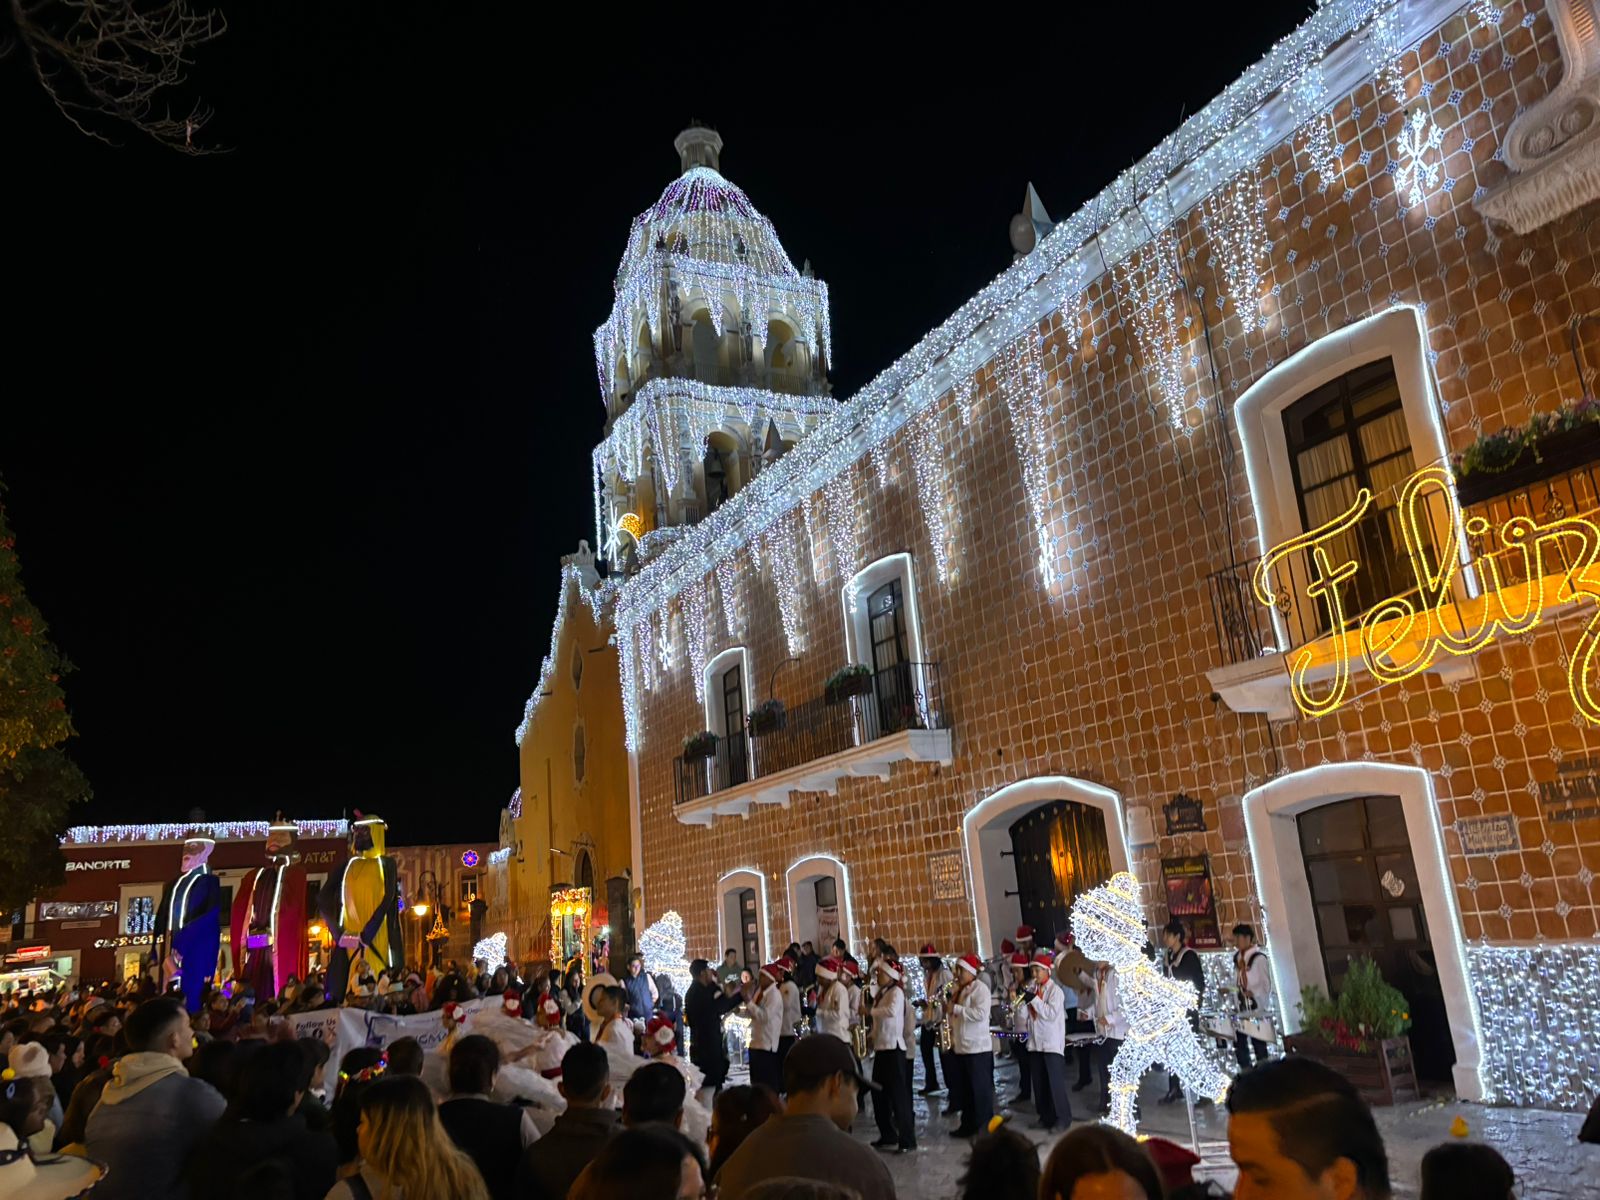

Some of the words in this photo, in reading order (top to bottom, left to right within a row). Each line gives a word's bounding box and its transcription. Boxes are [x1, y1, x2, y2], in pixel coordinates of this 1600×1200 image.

[1253, 466, 1600, 725] Feliz
[304, 850, 337, 864] AT&T
[65, 860, 131, 872] BANORTE
[296, 1020, 324, 1031] Follow
[326, 1018, 336, 1026] Us
